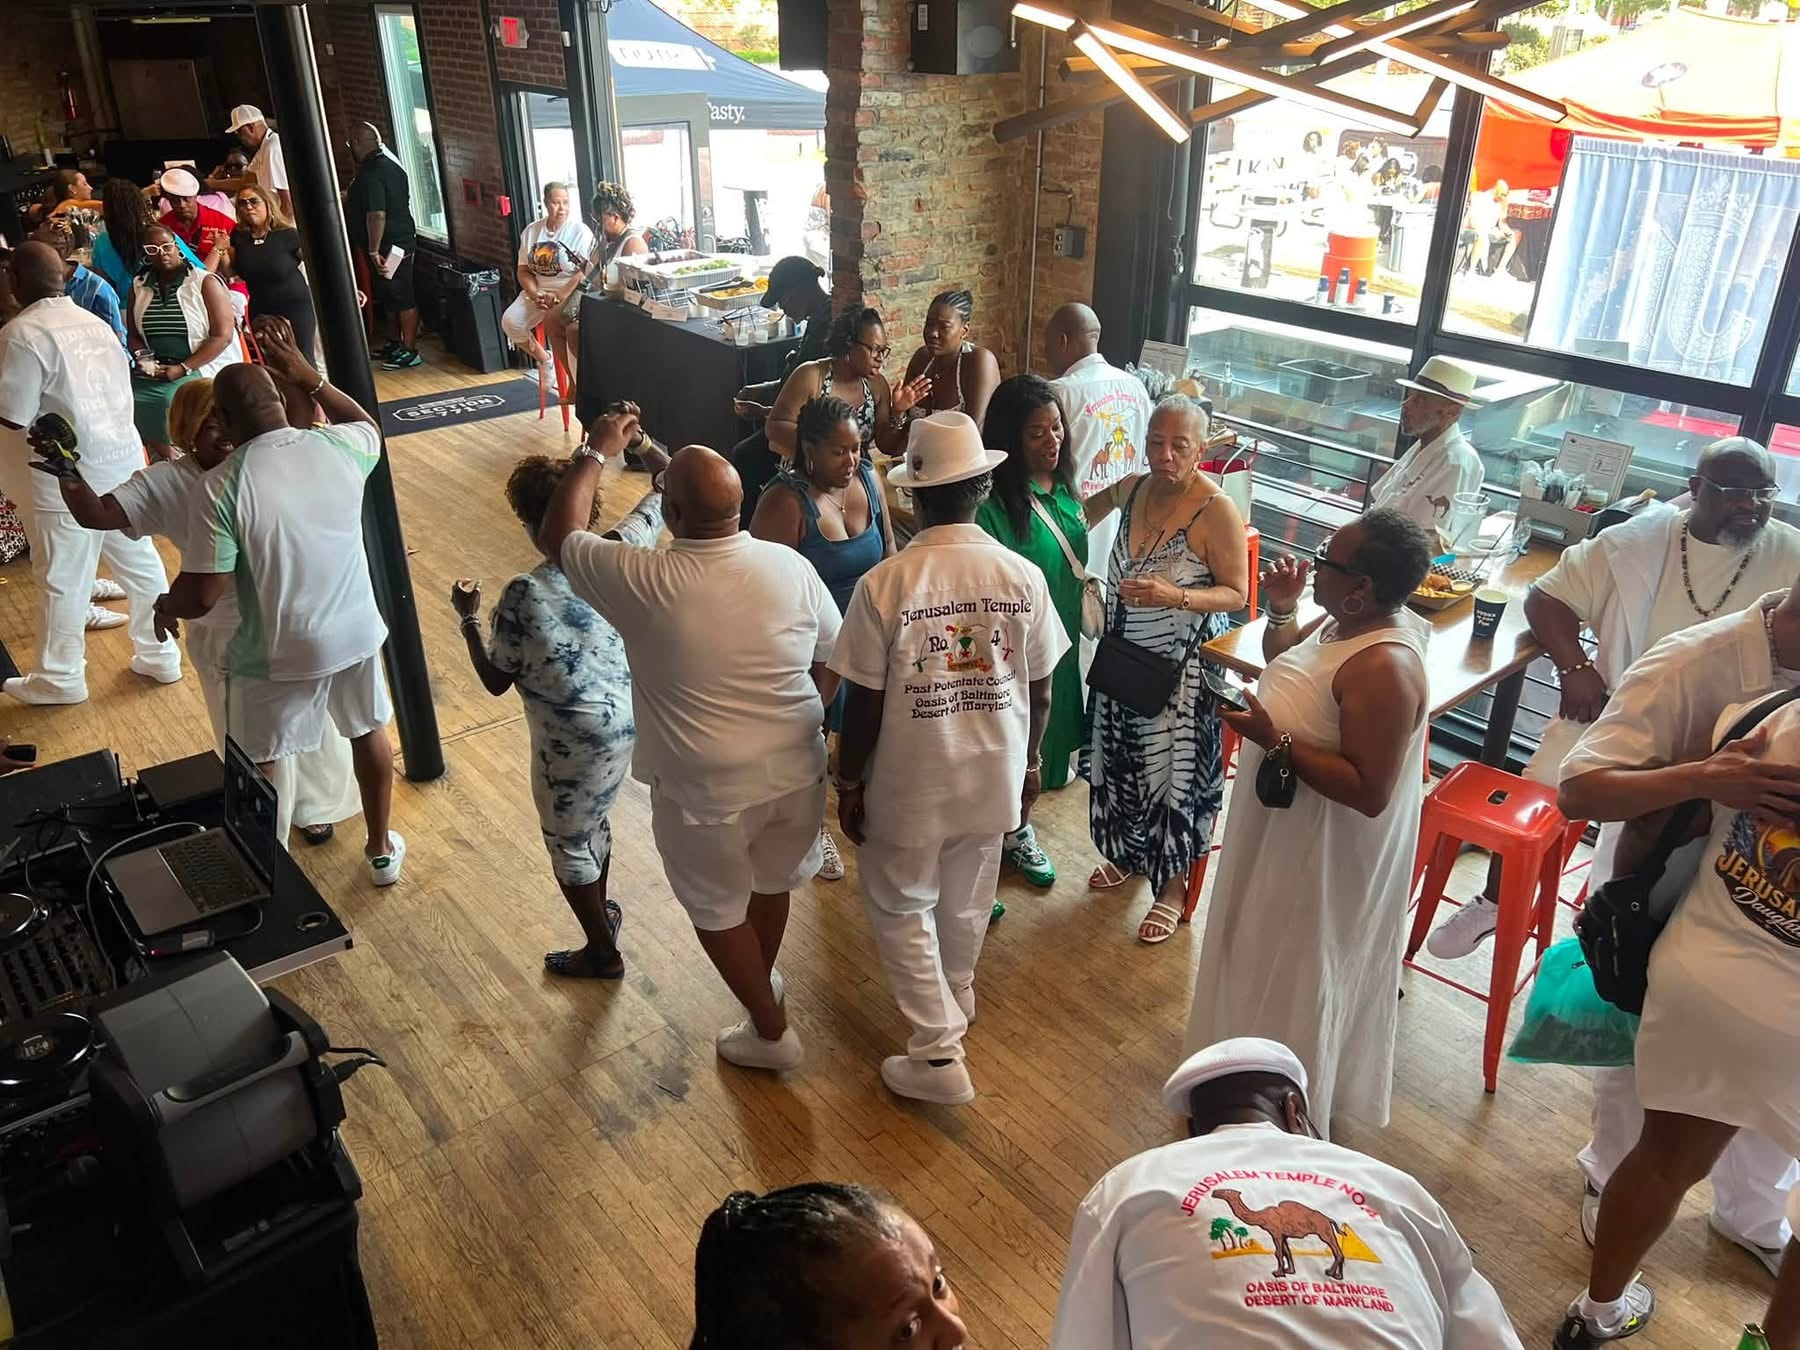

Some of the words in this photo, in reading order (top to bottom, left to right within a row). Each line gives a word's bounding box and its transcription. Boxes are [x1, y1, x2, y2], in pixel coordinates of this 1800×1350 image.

[706, 102, 745, 124] asty.
[407, 398, 493, 417] SECTION
[902, 601, 977, 626] Jerusalem
[981, 598, 1031, 616] Temple
[990, 630, 1001, 646] 4
[904, 684, 932, 694] Past
[934, 676, 985, 693] Potentate
[912, 707, 949, 719] Desert
[950, 702, 959, 714] of
[962, 696, 1013, 713] Maryland
[915, 697, 947, 708] Oasis
[949, 691, 957, 703] of
[961, 689, 1011, 701] Baltimore
[1717, 849, 1800, 920] JERUSA
[1180, 1169, 1260, 1217] JERUSALEM
[1261, 1170, 1337, 1189] TEMPLE
[1246, 1281, 1288, 1293] OASIS
[1291, 1281, 1309, 1293] OF
[1313, 1283, 1388, 1299] BALTIMORE
[1244, 1294, 1300, 1307] DESERT
[1302, 1295, 1320, 1306] OF
[1322, 1296, 1395, 1313] MARYLAND
